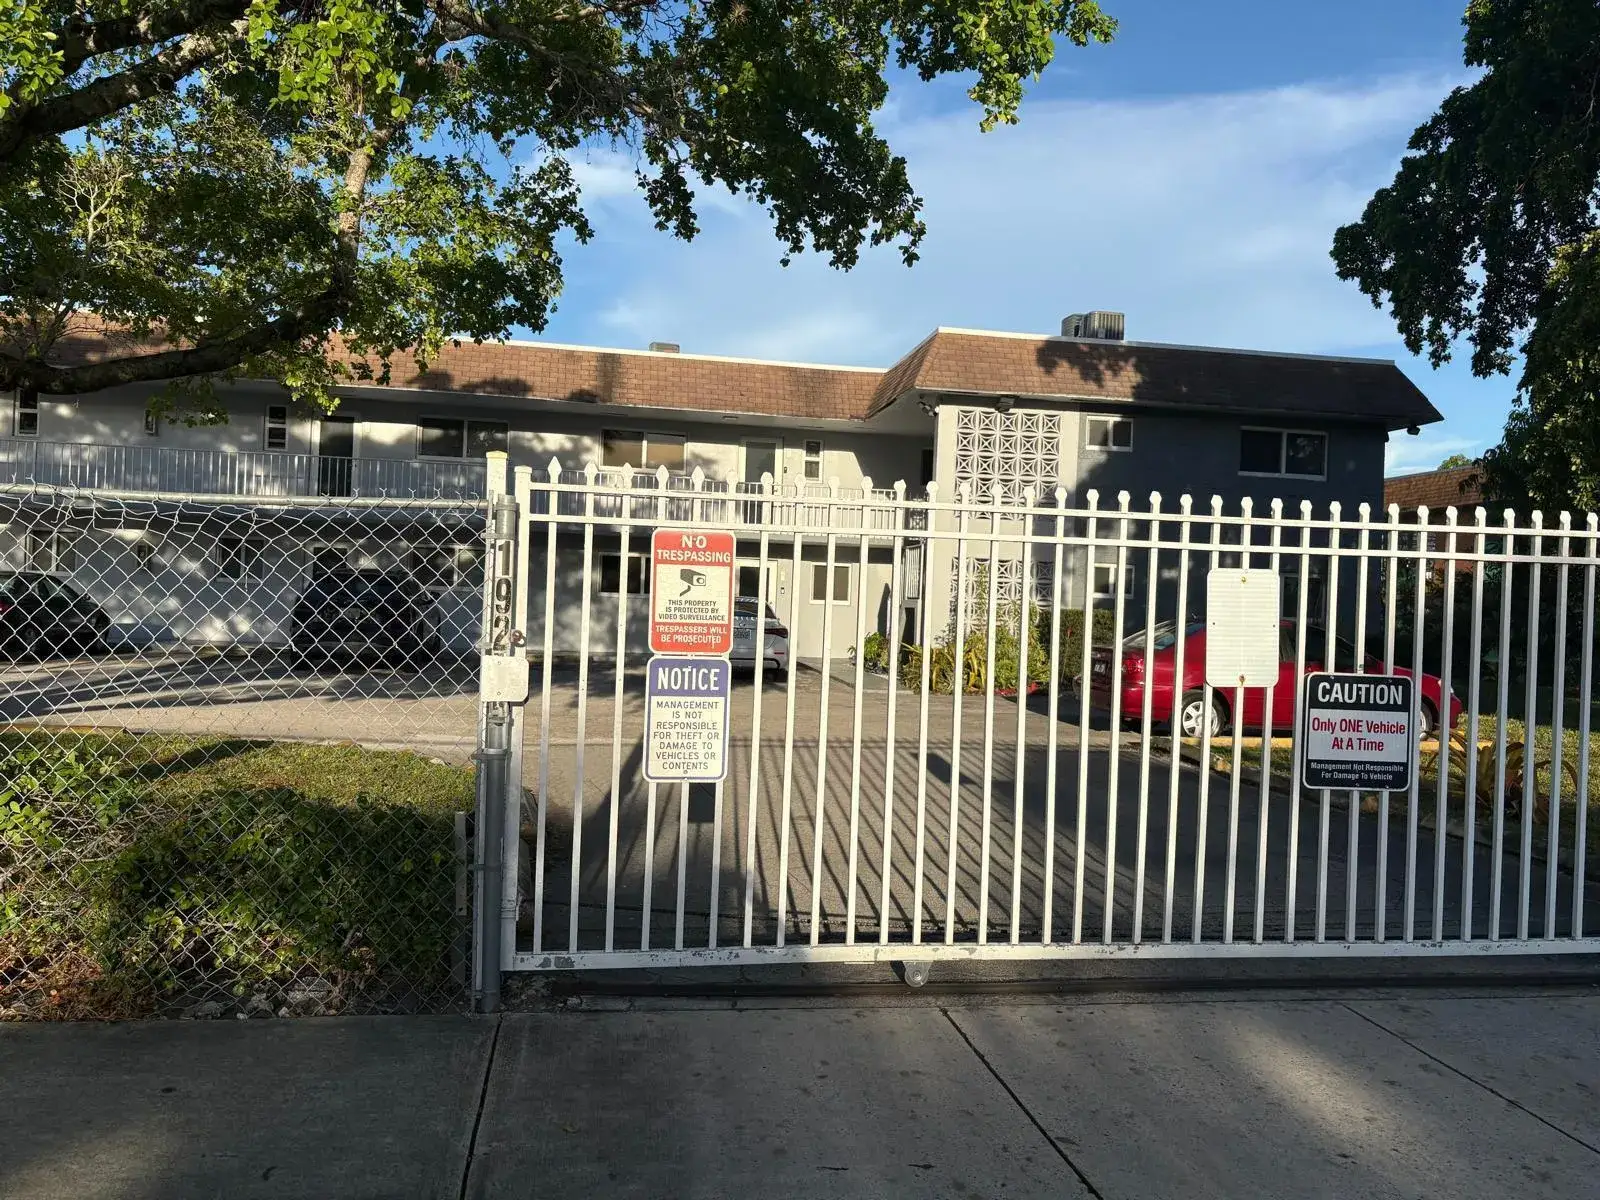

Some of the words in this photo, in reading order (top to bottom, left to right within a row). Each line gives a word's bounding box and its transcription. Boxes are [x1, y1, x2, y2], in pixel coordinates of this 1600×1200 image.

[681, 535, 707, 548] NO
[657, 550, 731, 562] TRESPASSING
[492, 540, 512, 656] 192
[656, 625, 707, 633] TRESPASSERS
[710, 626, 727, 634] WILL
[673, 635, 721, 643] PROSECUTED
[658, 667, 720, 691] NOTICE
[1318, 682, 1403, 705] CAUTION
[657, 701, 719, 709] MANAGEMENT
[657, 722, 717, 730] RESPONSIBLE
[1312, 717, 1336, 734] Only
[1340, 719, 1363, 733] ONE
[1366, 720, 1405, 734] Vehicle
[707, 732, 719, 740] OR
[1332, 737, 1344, 750] At
[1346, 737, 1354, 750] A
[1357, 738, 1384, 751] Time
[1311, 762, 1351, 770] Management
[1353, 763, 1364, 771] Not
[1365, 764, 1403, 772] Responsible
[1334, 772, 1359, 780] Damage
